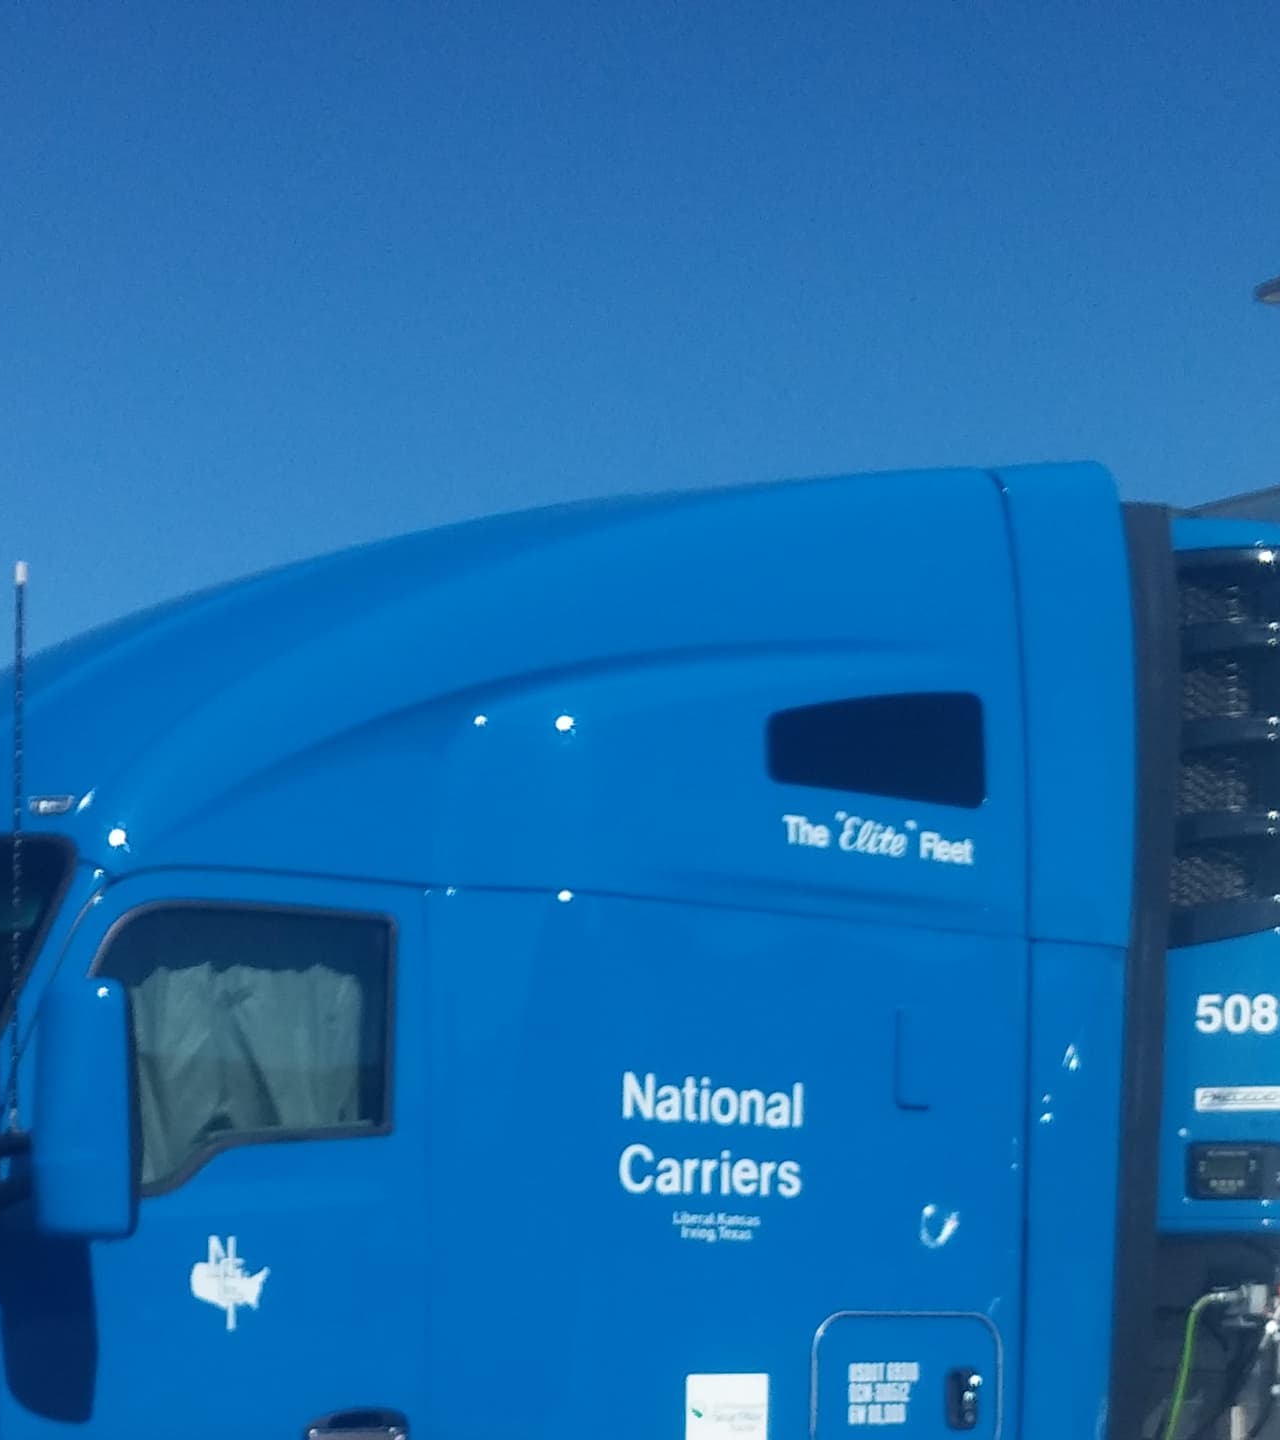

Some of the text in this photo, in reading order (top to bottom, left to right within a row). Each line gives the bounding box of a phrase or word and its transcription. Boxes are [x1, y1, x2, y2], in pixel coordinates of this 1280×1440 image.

[783, 813, 830, 848] The
[920, 831, 974, 865] Fleet
[622, 1071, 804, 1129] National
[620, 1144, 802, 1199] Carriers
